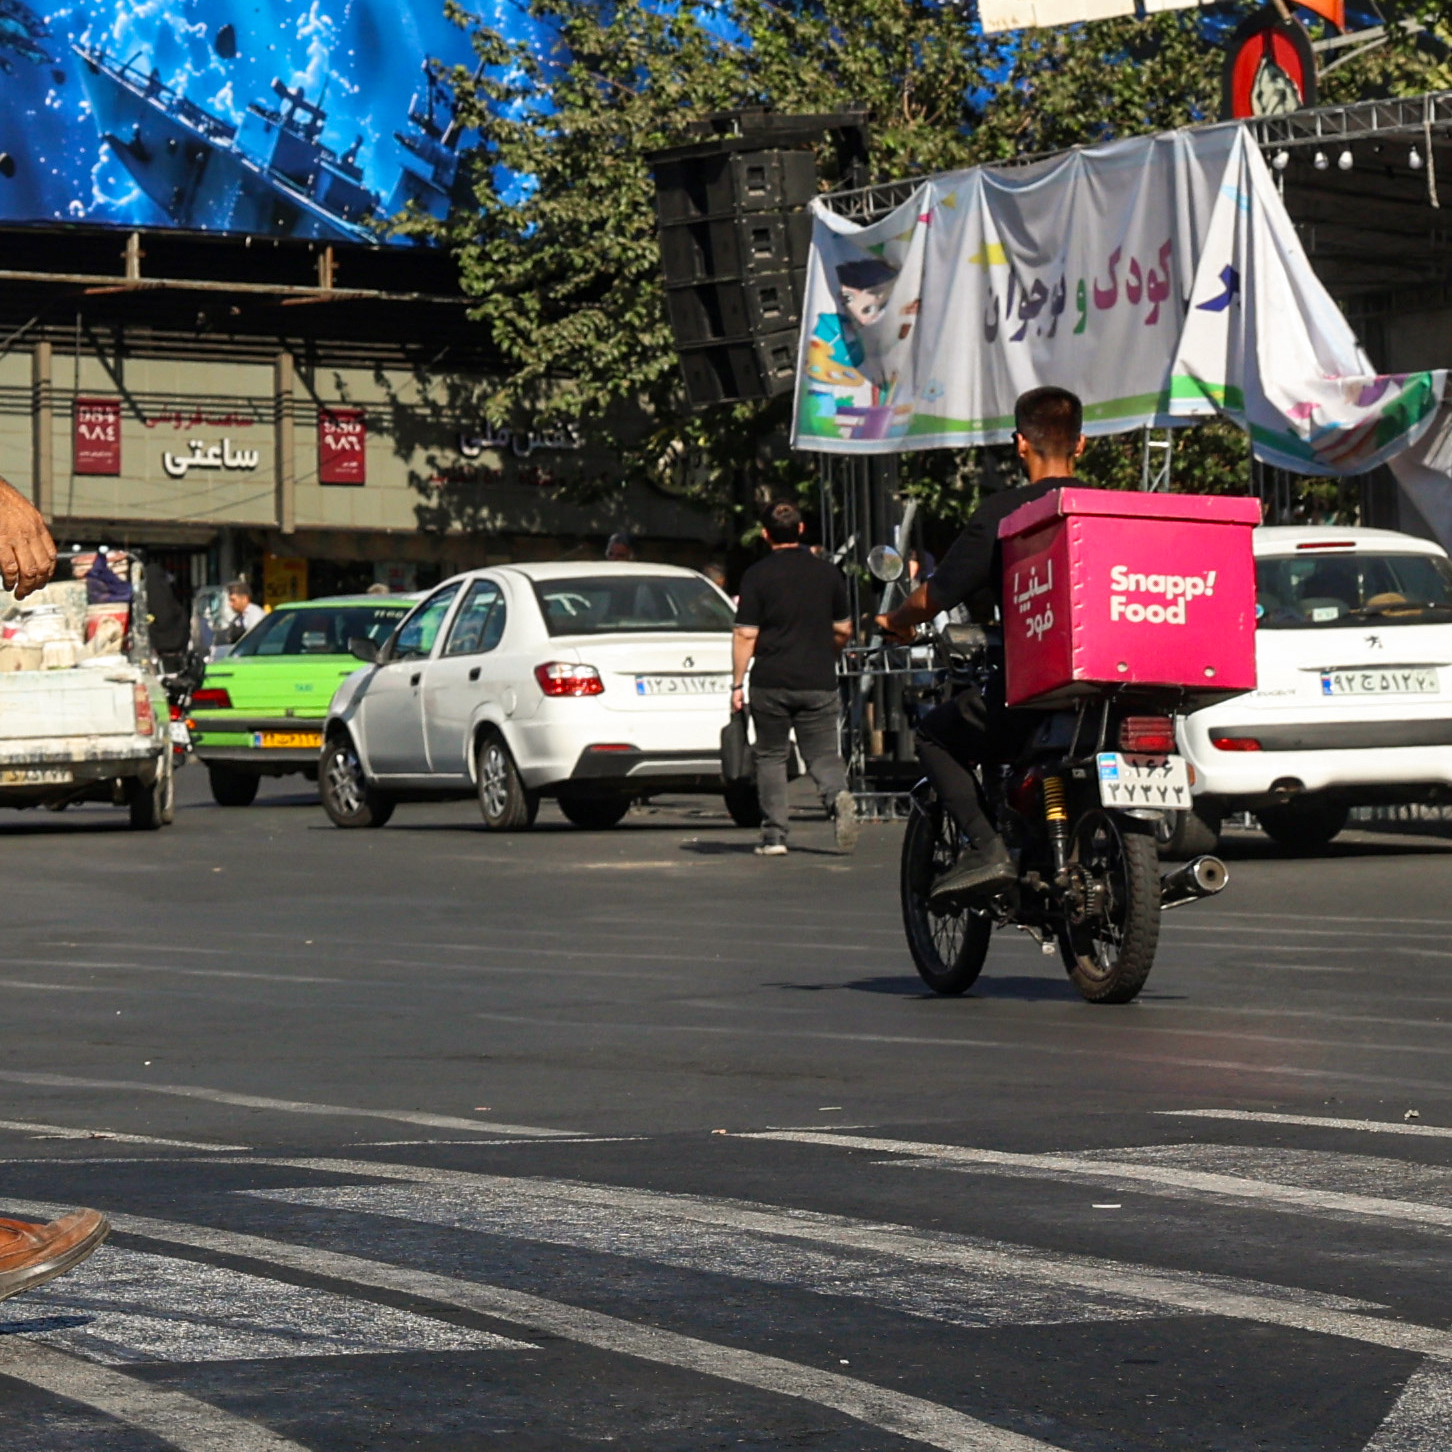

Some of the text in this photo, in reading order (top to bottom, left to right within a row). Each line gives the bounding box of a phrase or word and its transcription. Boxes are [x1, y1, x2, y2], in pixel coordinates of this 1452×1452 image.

[1092, 237, 1172, 326] کودک
[1072, 277, 1088, 335] و
[163, 438, 259, 475] ساعتی
[1110, 565, 1217, 601] Snapp!
[1109, 595, 1187, 625] Food
